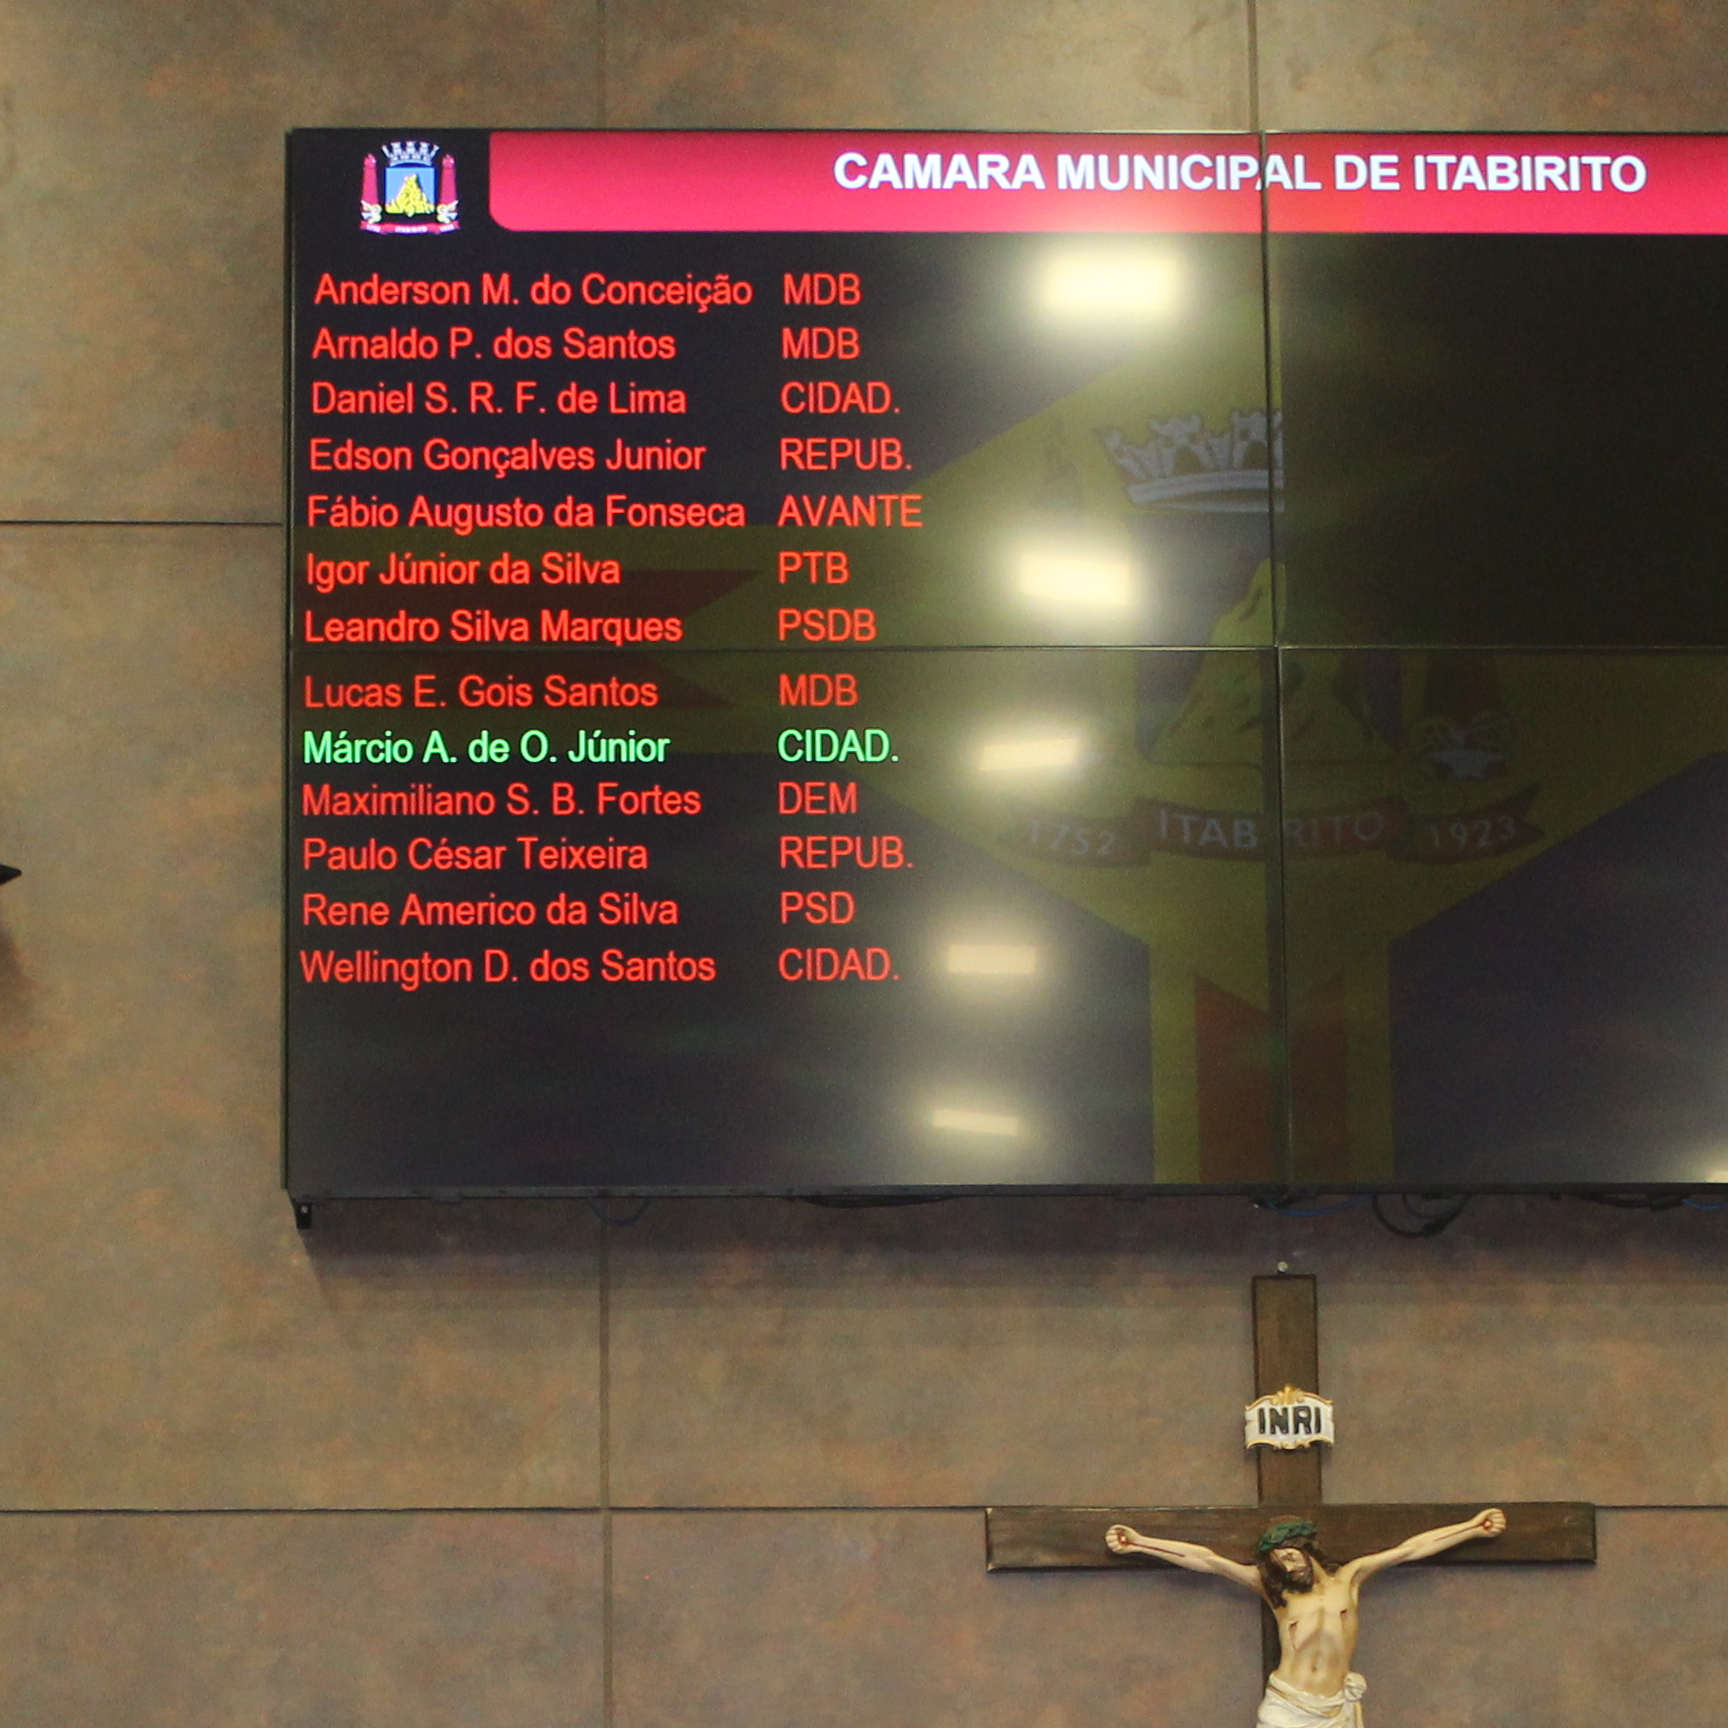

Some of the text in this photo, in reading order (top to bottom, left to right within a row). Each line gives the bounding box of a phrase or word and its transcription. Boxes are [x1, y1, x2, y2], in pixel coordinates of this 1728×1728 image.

[833, 151, 1648, 193] CAMARA MUNICIPAL DE ITABIRITO
[313, 271, 864, 314] Anderson M. do Conceição MDB
[310, 325, 862, 360] Arnaldo P. dos Santos MDB
[311, 379, 902, 415] Daniel S. R. F. de Lima CIDAD.
[308, 436, 914, 480] Edson Gonçalves Junior REPUB.
[306, 493, 925, 537] Fábio Augusto da Fonseca AVANTE
[305, 550, 852, 595] Igor Júnior da Silva PTB
[303, 607, 879, 647] Leandro Silva Marques PSDB
[304, 672, 860, 709] Lucas E. Gois Santos MDB
[303, 728, 899, 764] Márcio A. de O. Júnior CIDAD.
[301, 780, 859, 817] Maximiliano S. B. Fortes DEM
[302, 834, 914, 871] Paulo César Teixeira REPUB.
[302, 890, 857, 927] Rene Americo da Silva PSD
[299, 946, 900, 993] Wellington D. dos Santos CIDAD.
[1257, 1405, 1322, 1435] INRI
